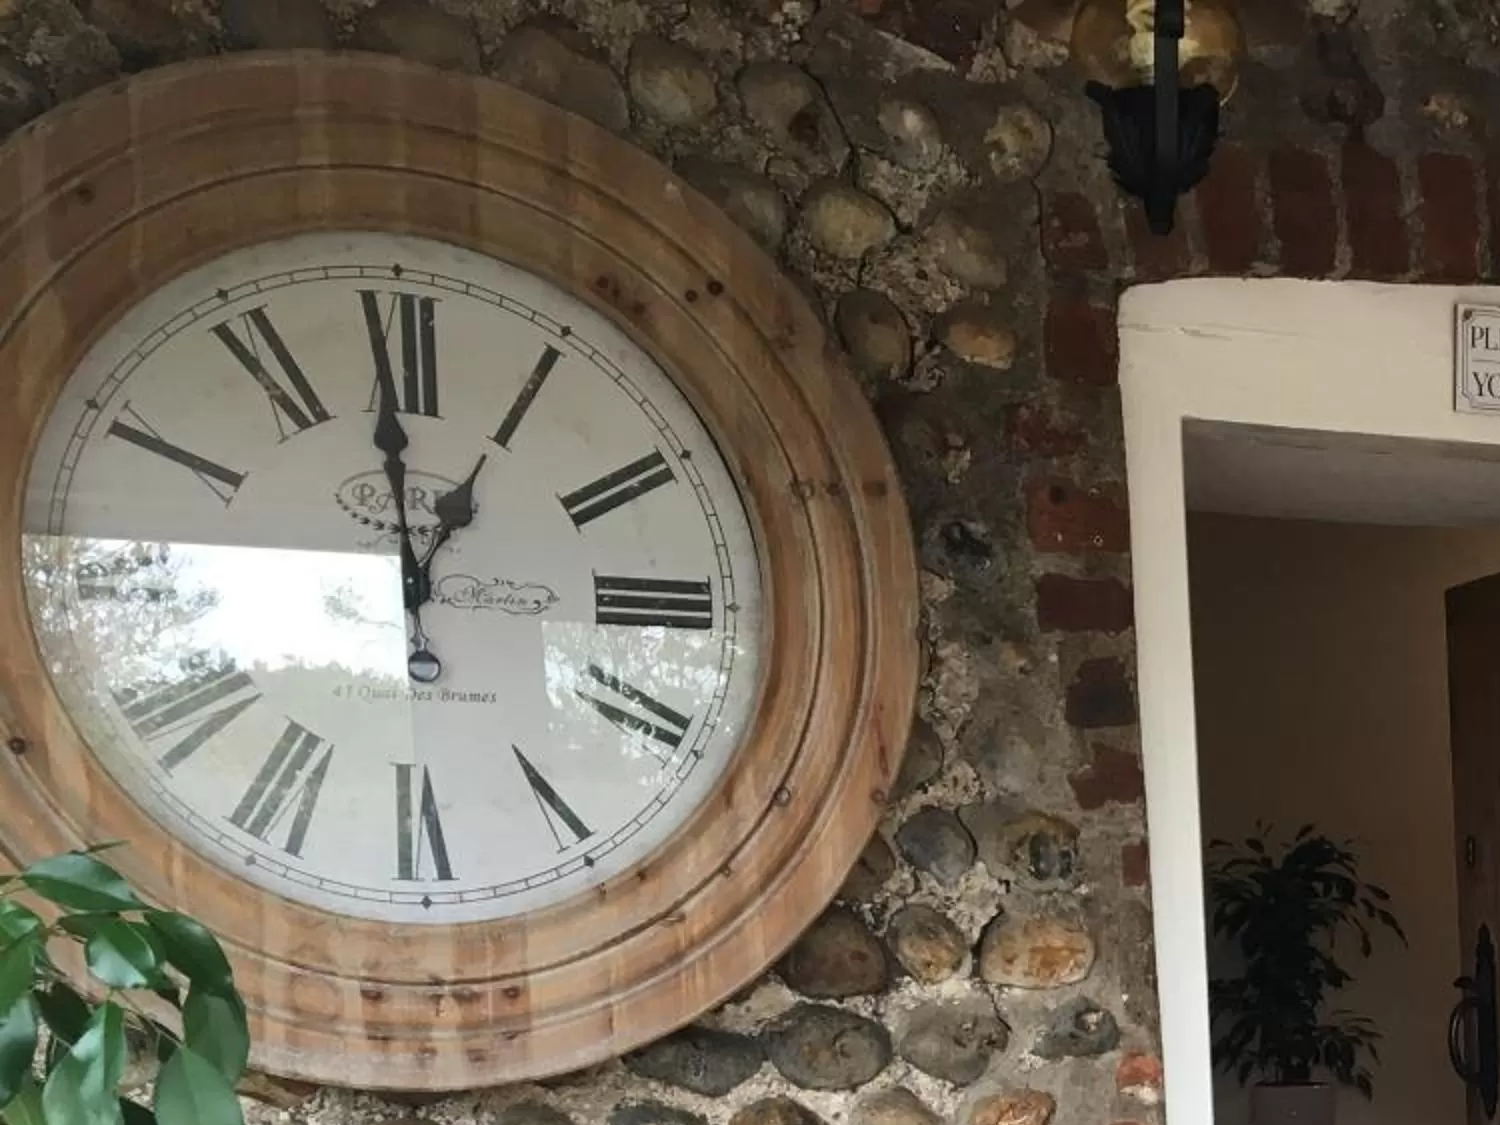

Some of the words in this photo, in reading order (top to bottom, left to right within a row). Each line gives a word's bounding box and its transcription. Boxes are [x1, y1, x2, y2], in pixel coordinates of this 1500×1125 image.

[208, 303, 338, 444] XI
[354, 290, 445, 420] XII
[486, 342, 567, 453] I
[104, 400, 249, 508] X
[555, 446, 679, 533] II
[592, 568, 714, 636] III
[221, 715, 335, 860] VII
[390, 762, 460, 881] VI
[511, 744, 597, 854] V
